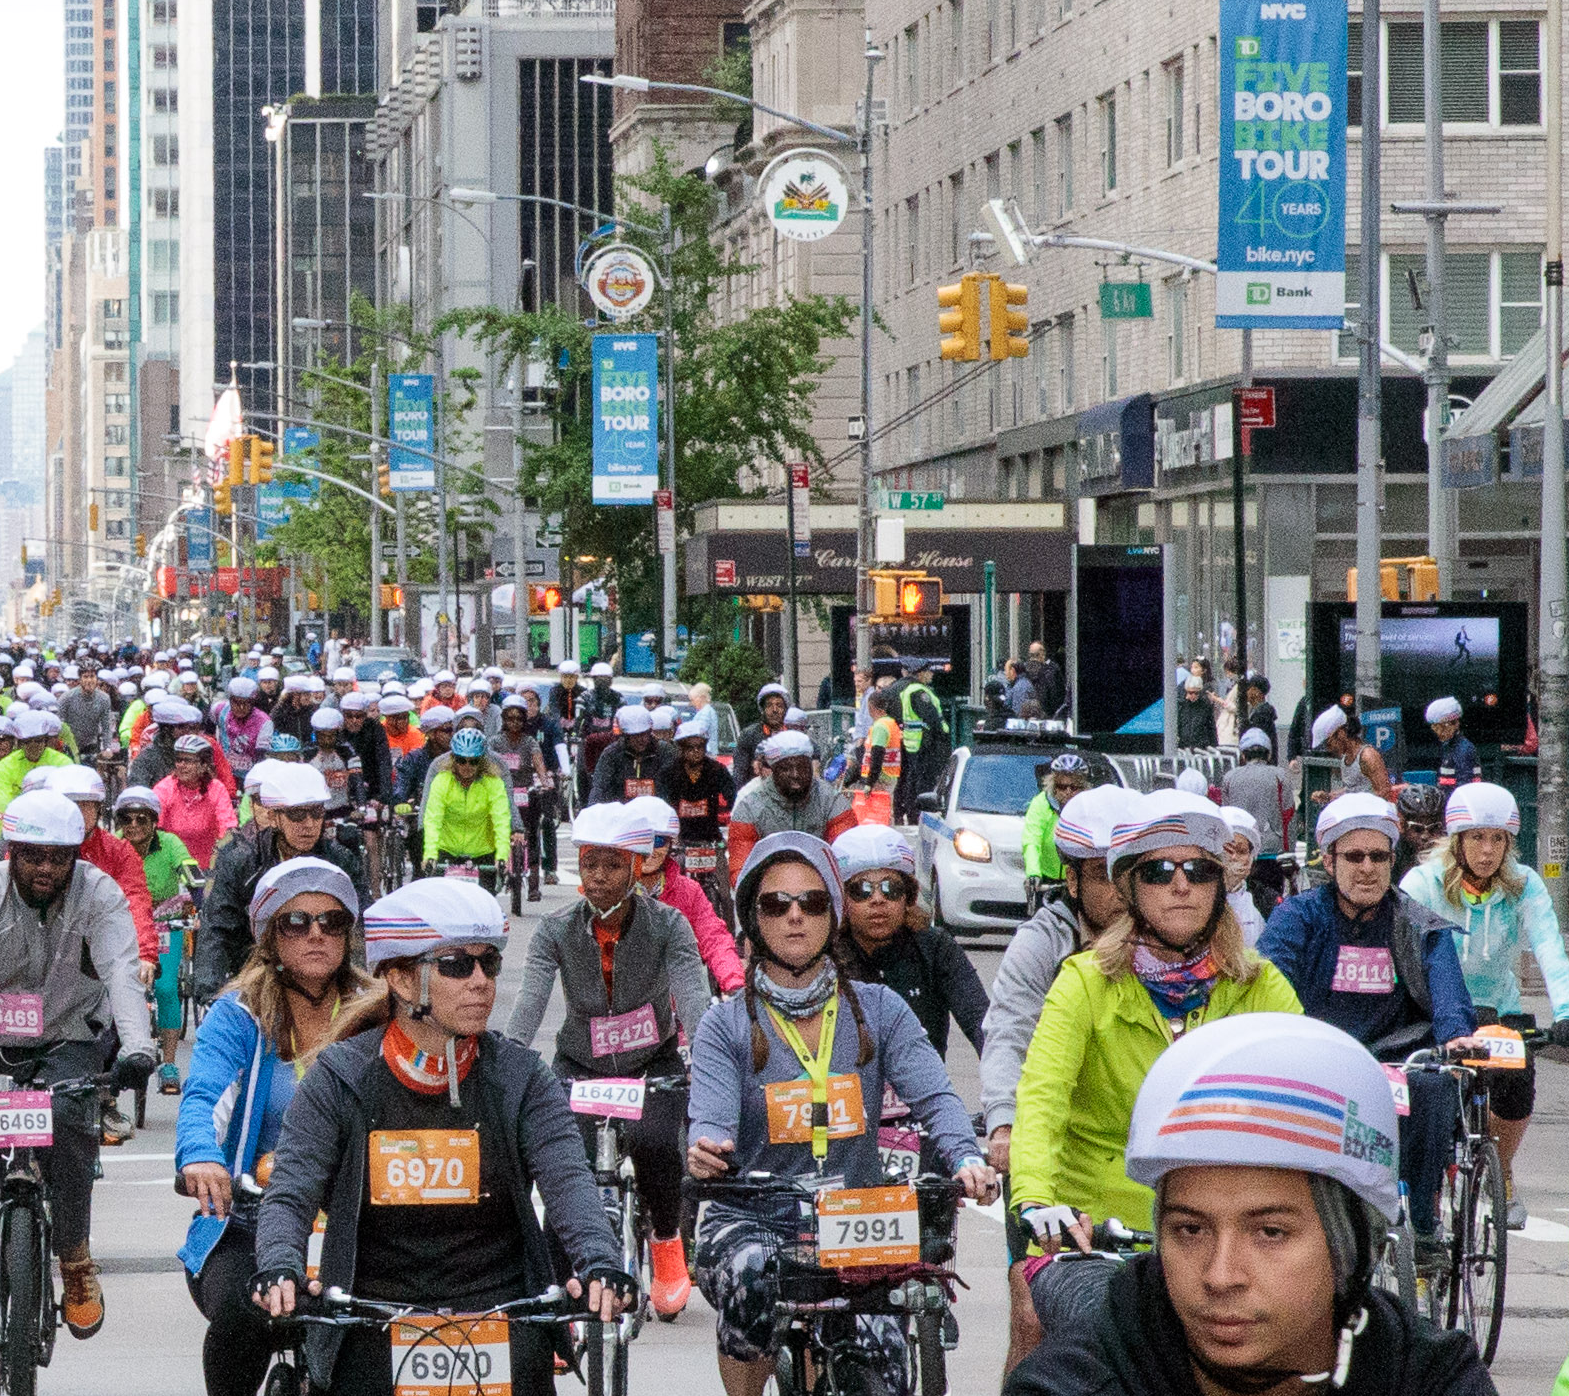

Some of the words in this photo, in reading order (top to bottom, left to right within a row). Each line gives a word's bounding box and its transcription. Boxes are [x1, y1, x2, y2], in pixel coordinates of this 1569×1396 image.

[1260, 4, 1307, 21] NYC
[1235, 63, 1330, 92] FIVE
[1234, 91, 1332, 122] BORO
[1235, 121, 1330, 151] BIKE
[1235, 150, 1330, 181] TOUR
[1281, 203, 1323, 218] YEARS
[787, 227, 826, 240] HAITI
[1247, 246, 1317, 267] bike.nyc
[1276, 287, 1314, 299] Bank
[891, 494, 903, 509] W
[910, 494, 929, 509] 57
[910, 550, 974, 568] House
[1375, 726, 1391, 749] P
[595, 1019, 655, 1047] 16470
[576, 1084, 640, 1104] 16470
[782, 1098, 851, 1130] 791
[386, 1156, 465, 1188] 6970
[835, 1217, 906, 1245] 7991
[410, 1349, 494, 1381] 6970
